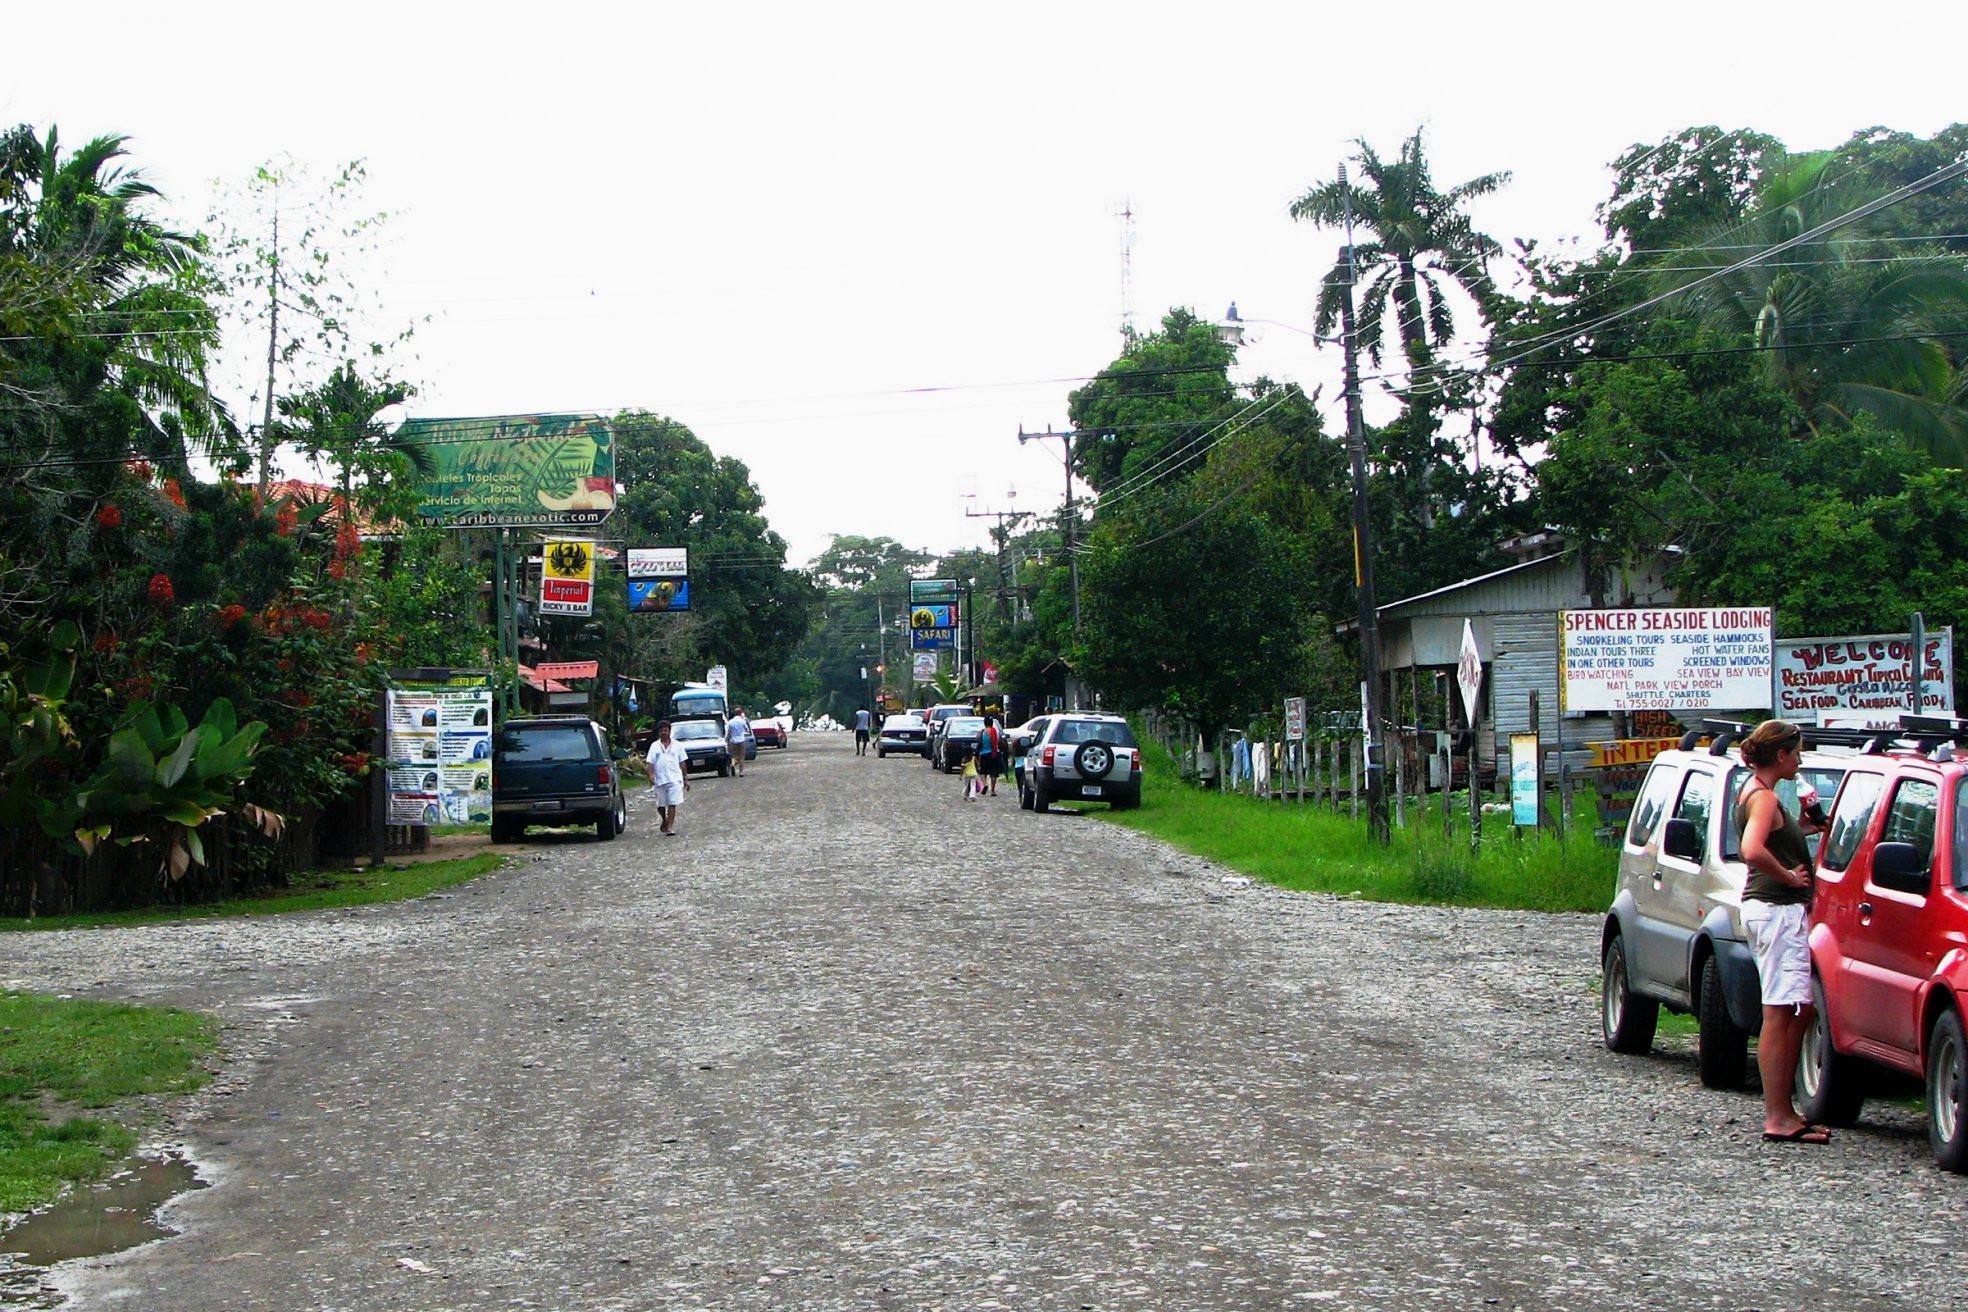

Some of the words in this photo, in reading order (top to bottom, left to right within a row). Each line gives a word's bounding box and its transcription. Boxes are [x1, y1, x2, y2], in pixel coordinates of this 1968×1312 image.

[467, 472, 522, 485] Tropicales
[490, 484, 522, 494] Tapas
[464, 496, 478, 505] de
[481, 495, 522, 504] Internet
[550, 580, 583, 600] Imperial
[573, 604, 588, 612] BAR
[1566, 613, 1637, 631] SPENCER
[1642, 611, 1708, 630] SEASIDE
[1712, 610, 1771, 629] LODGING
[917, 629, 951, 640] SAFARI
[1577, 635, 1633, 645] SNORKELING
[1636, 635, 1665, 644] TOURS
[1671, 634, 1710, 644] SEASIDE
[1713, 633, 1764, 643] HAMMOCKS
[1567, 647, 1597, 657] INDIAN
[1601, 646, 1627, 656] TOURS
[1630, 646, 1656, 655] THREE
[1692, 645, 1710, 655] HOT
[1714, 645, 1744, 654] WATER
[1748, 644, 1770, 654] FANS
[1567, 659, 1576, 668] IN
[1578, 659, 1594, 668] ONE
[1597, 658, 1625, 668] OTHER
[1628, 657, 1655, 667] TOURS
[1683, 656, 1727, 666] SCREENED
[1729, 655, 1770, 666] WINDOWS
[1567, 670, 1585, 680] BIRD
[1587, 669, 1634, 679] WATCHING
[1677, 668, 1695, 678] SEA
[1697, 668, 1720, 678] VIEW
[1726, 667, 1744, 677] BAY
[1747, 667, 1770, 677] VIEW
[1781, 668, 1864, 687] RESTAURANT
[1635, 681, 1658, 690] PARK
[1664, 680, 1688, 690] VIEW
[1692, 680, 1723, 689] PORCH
[1626, 691, 1664, 699] SHUTTLE
[1669, 690, 1711, 698] CHARTERS
[1630, 699, 1674, 708] 755-0027
[1686, 698, 1709, 707] 0210
[1849, 694, 1902, 710] CARIBBEAN
[1906, 692, 1939, 707] FOD
[1634, 711, 1667, 723] HIGH
[1636, 723, 1679, 737] SPEED
[1603, 738, 1712, 764] INTER
